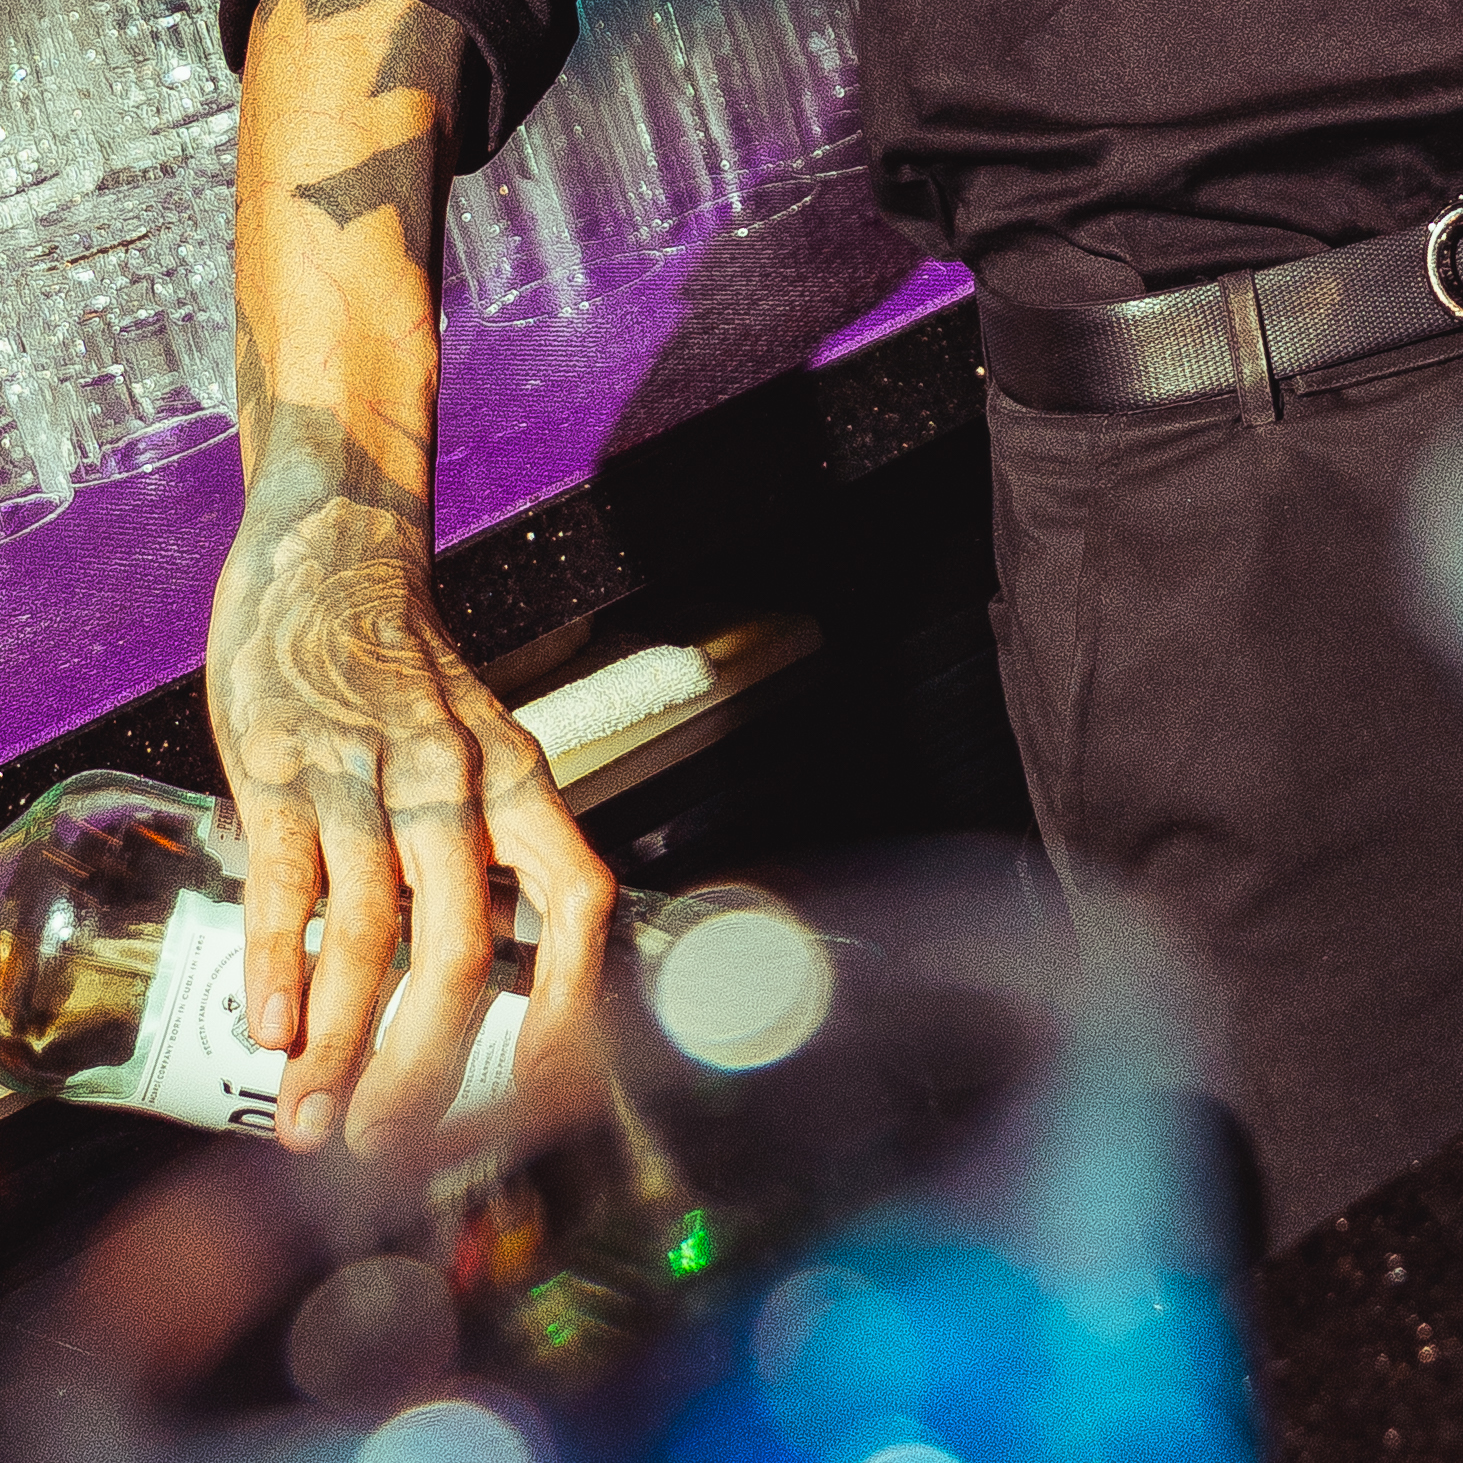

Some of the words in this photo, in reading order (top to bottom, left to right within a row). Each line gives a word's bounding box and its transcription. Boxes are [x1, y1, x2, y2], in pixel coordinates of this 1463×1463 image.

[211, 945, 244, 980] ORIGINAL
[158, 1043, 174, 1081] COMPANY
[171, 1017, 183, 1042] BORN
[178, 1003, 185, 1015] IN
[182, 974, 195, 1000] CUBA
[191, 959, 198, 971] IN
[199, 982, 213, 1023] FAMILIAR
[199, 1024, 213, 1056] RECETA
